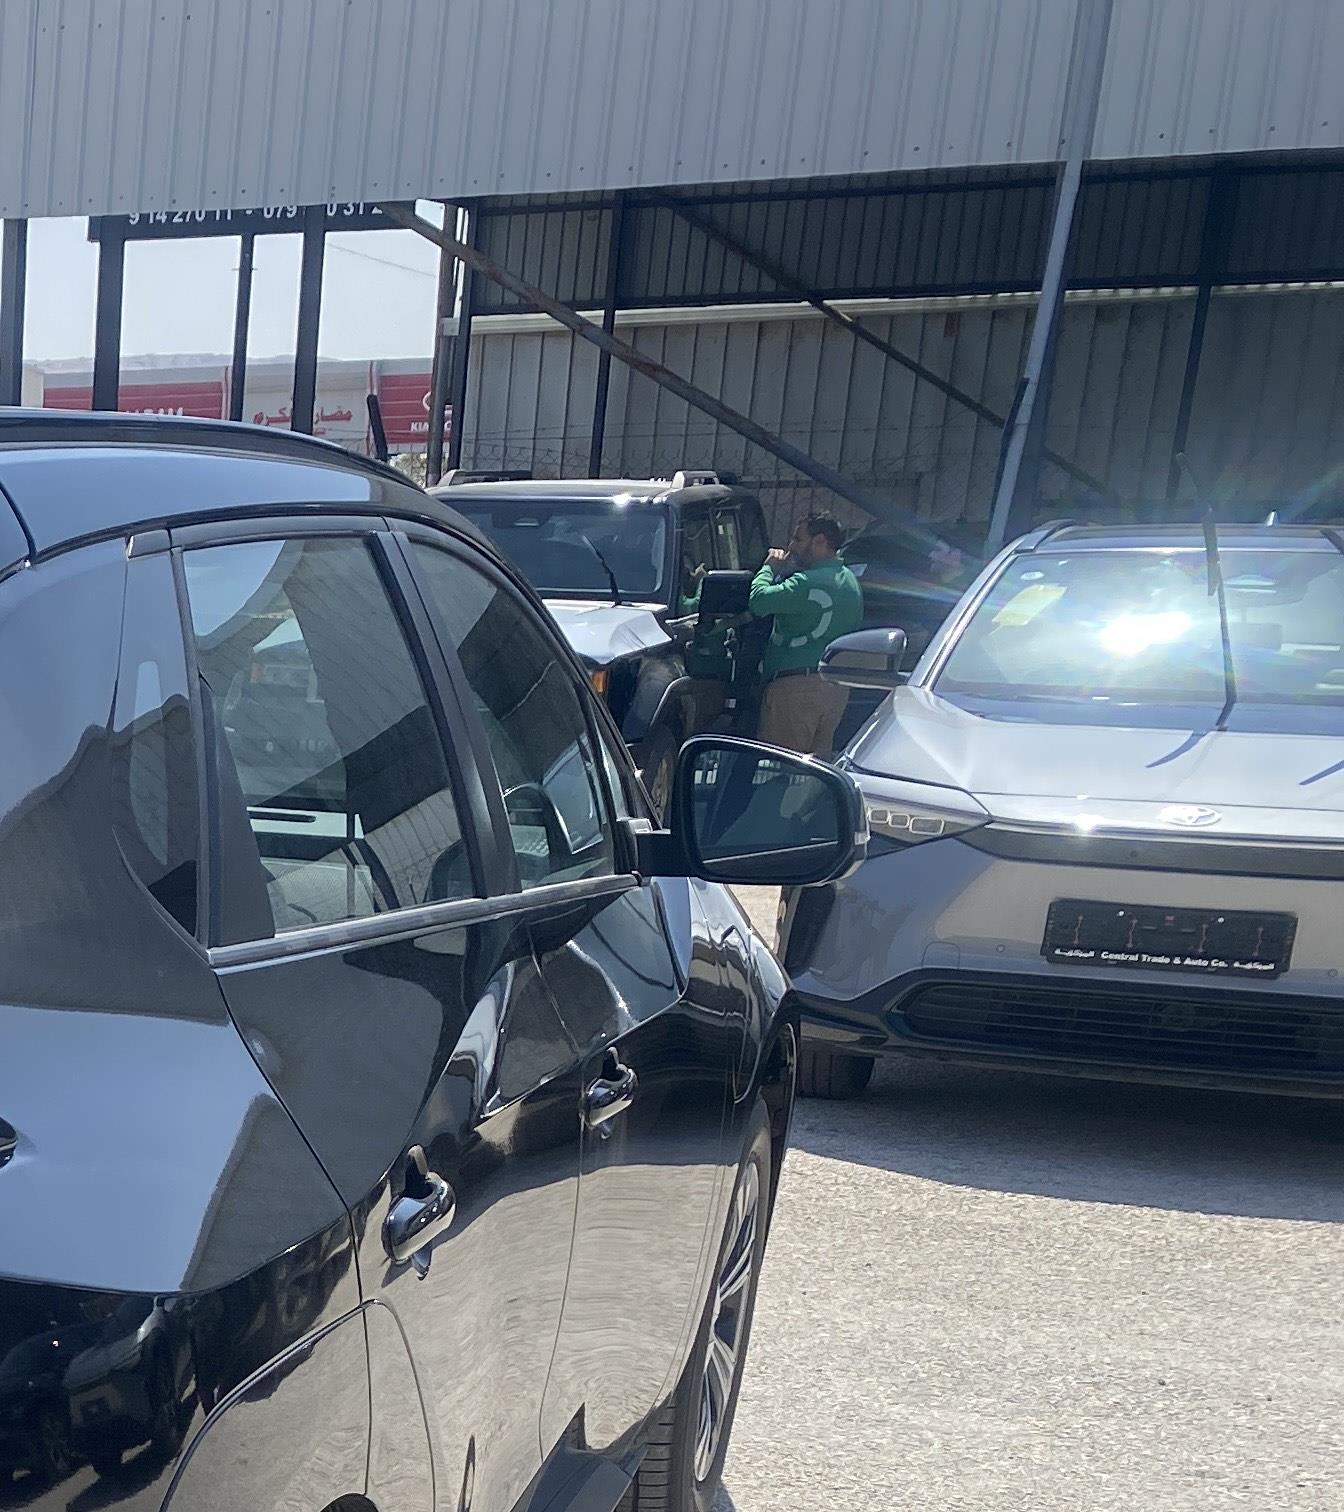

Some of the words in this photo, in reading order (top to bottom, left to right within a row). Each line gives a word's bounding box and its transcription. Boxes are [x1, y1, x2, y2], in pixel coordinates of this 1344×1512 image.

[1100, 951, 1139, 962] Central
[1141, 953, 1171, 964] Trade
[1183, 957, 1209, 967] Auto
[1211, 958, 1229, 968] Co.
